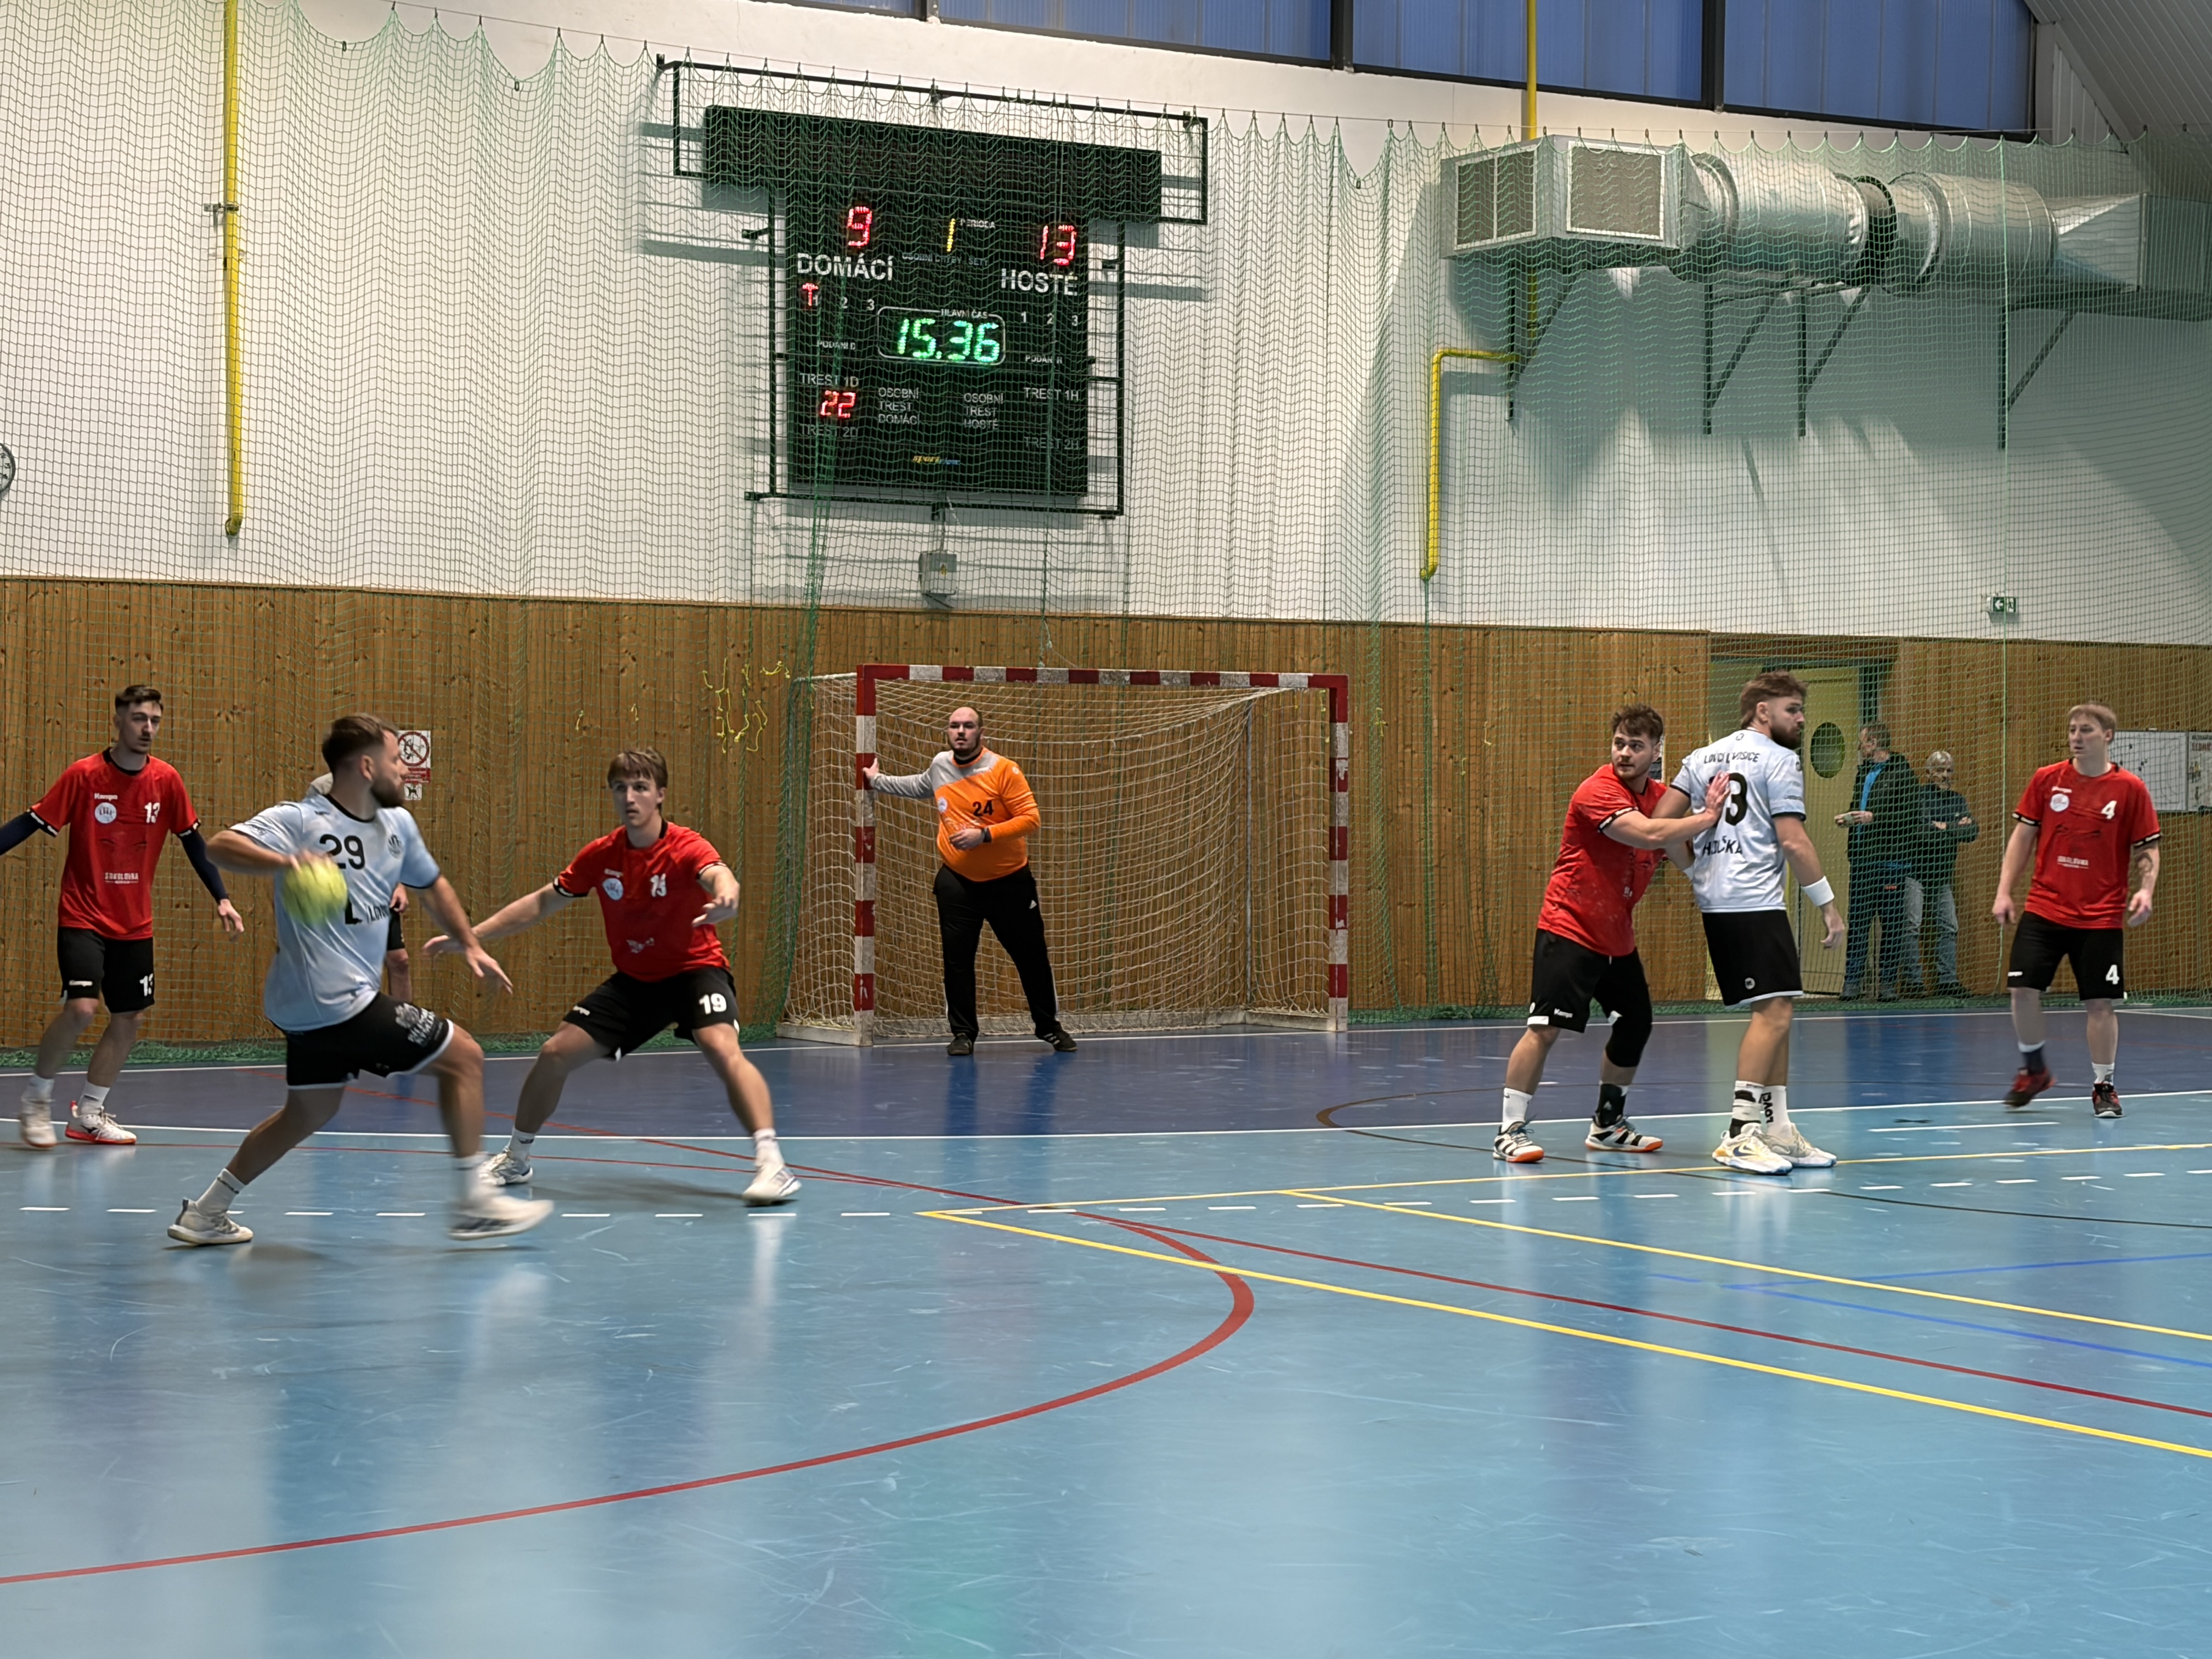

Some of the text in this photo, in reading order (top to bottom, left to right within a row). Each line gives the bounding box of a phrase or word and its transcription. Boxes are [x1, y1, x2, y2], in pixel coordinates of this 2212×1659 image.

[847, 206, 873, 246] 9
[946, 218, 956, 252] 1
[1040, 225, 1077, 267] 13
[797, 252, 894, 281] DOMÁCÍ
[1001, 268, 1078, 296] HOSTÉ
[866, 298, 874, 311] 3
[971, 310, 989, 319] ČAS
[1021, 311, 1079, 326] 1 2 3
[799, 373, 859, 387] TREST 1D
[878, 387, 919, 399] OSOBNÍ
[964, 392, 1003, 404] OSOBNÍ
[1024, 387, 1079, 402] TREST 1H
[821, 390, 856, 418] 22
[878, 400, 912, 412] TREST
[964, 406, 997, 417] TREST
[799, 423, 858, 438] TREST 2D
[1024, 436, 1079, 450] TREST 2H
[973, 800, 994, 816] 24
[2101, 800, 2117, 820] 4
[319, 834, 365, 870] 29
[2105, 964, 2120, 985] 4
[699, 992, 727, 1014] 19
